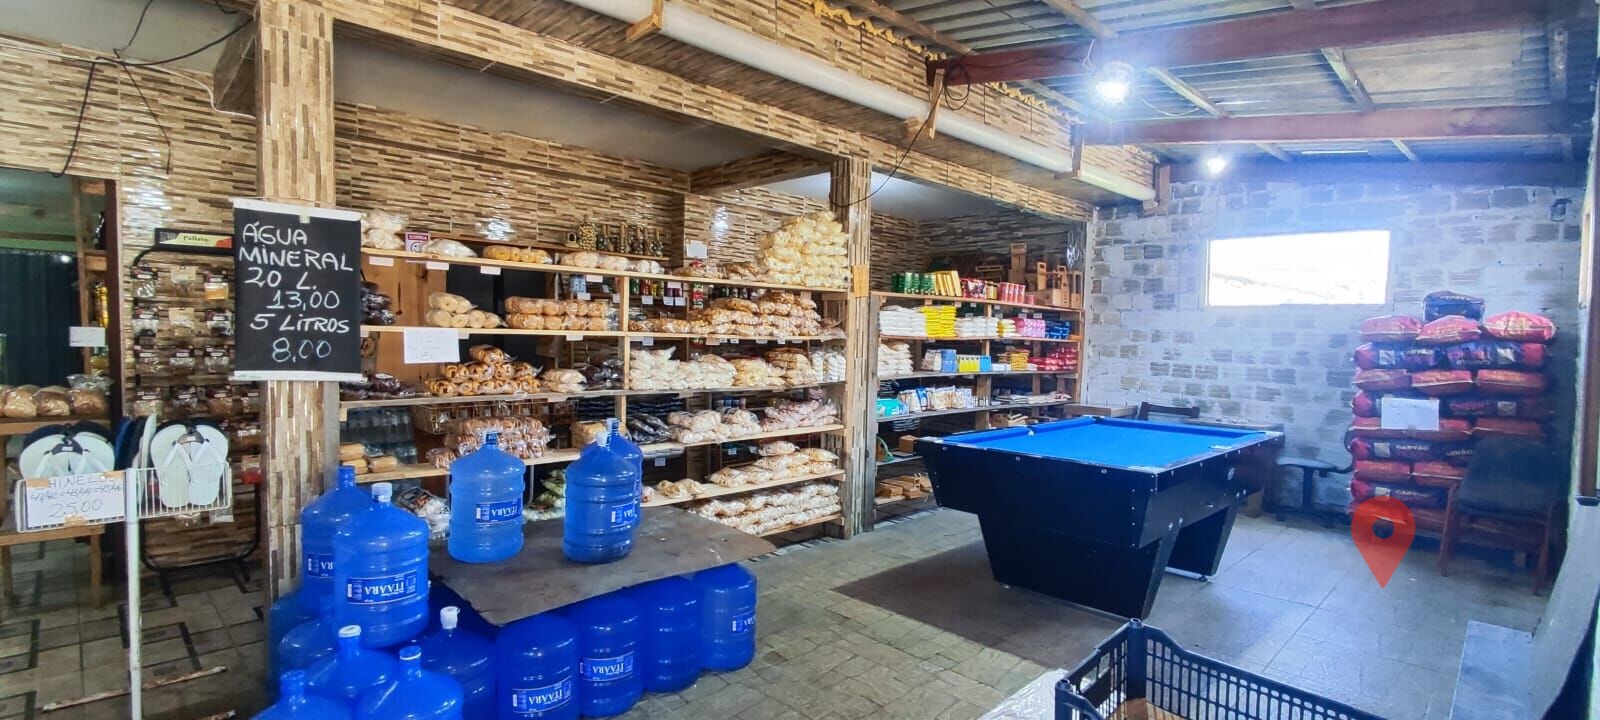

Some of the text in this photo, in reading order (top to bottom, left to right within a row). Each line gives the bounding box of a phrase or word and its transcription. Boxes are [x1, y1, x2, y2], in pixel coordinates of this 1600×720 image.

[242, 221, 308, 246] ÁGUA
[239, 245, 354, 272] MINERAL
[244, 267, 318, 290] 20 L.
[266, 290, 340, 311] 13,00
[250, 313, 350, 334] 5 LITROS
[272, 337, 332, 363] 8,00
[364, 581, 405, 597] ITAARA
[593, 661, 624, 674] ITAARA
[528, 688, 563, 705] ITAARA
